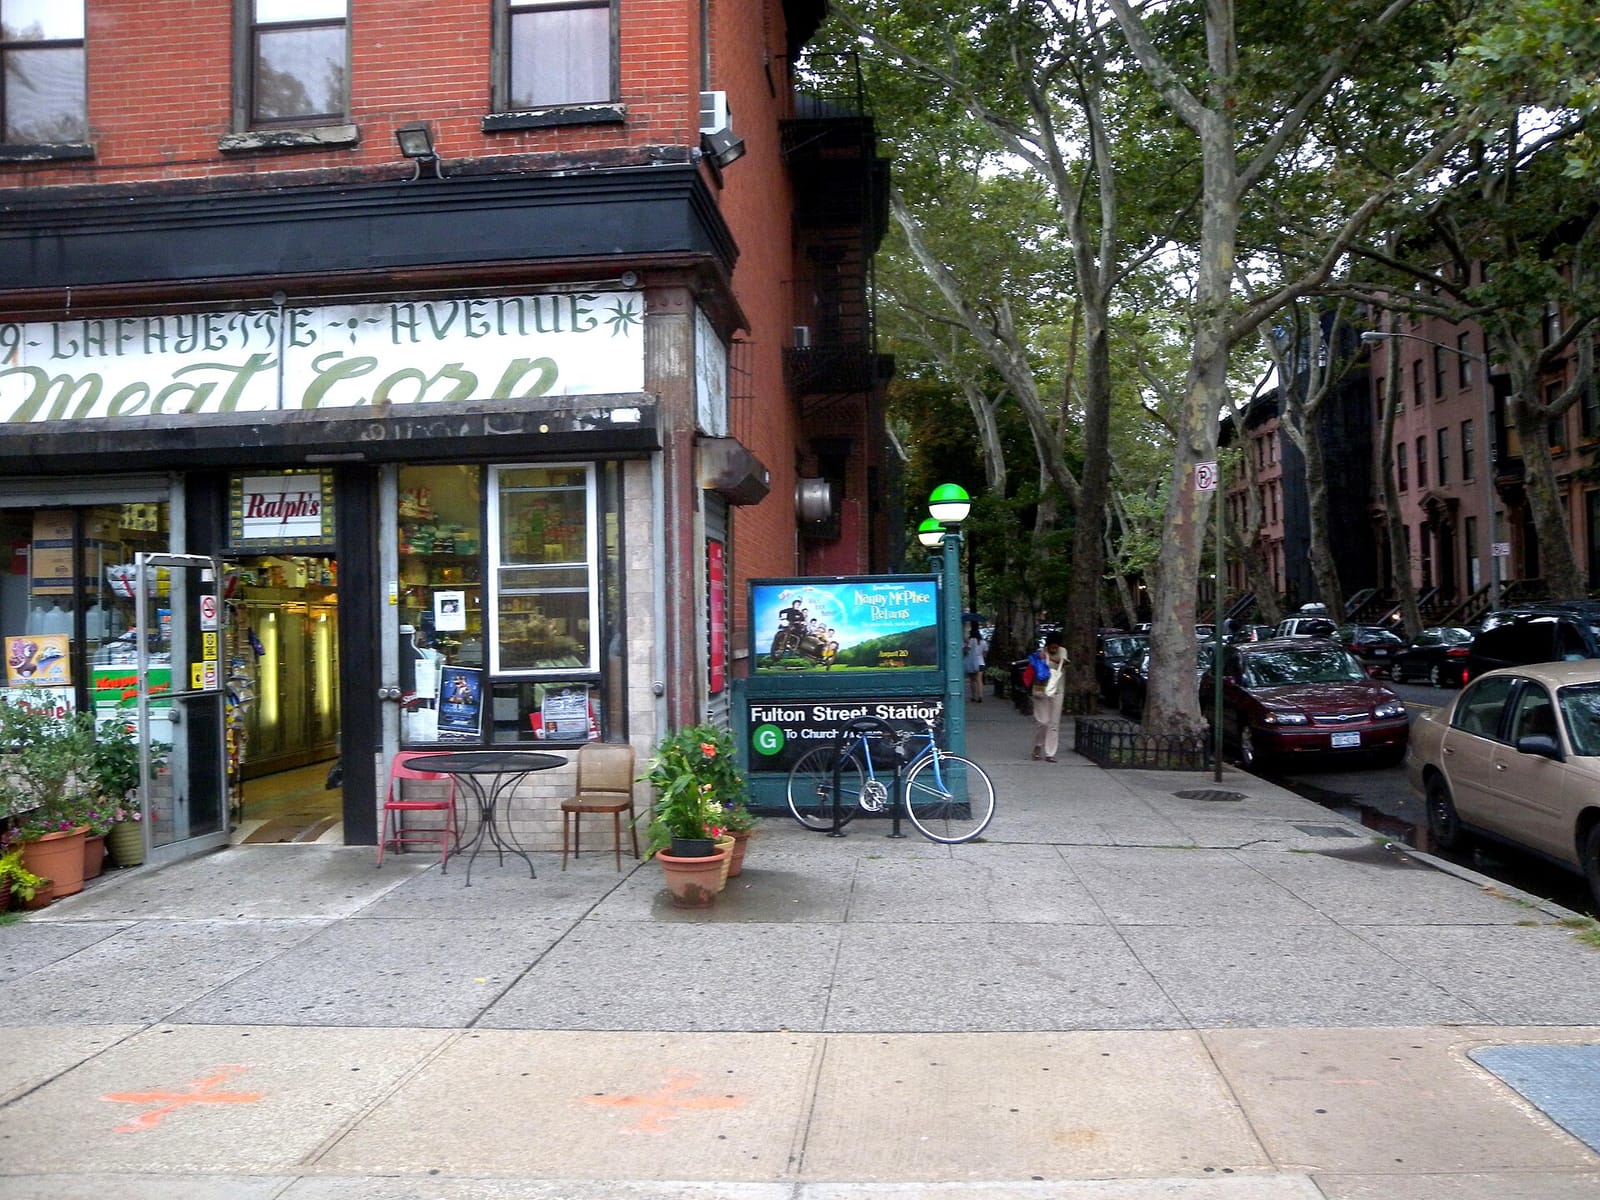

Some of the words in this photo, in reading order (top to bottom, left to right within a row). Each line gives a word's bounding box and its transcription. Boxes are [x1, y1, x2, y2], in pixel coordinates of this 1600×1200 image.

[390, 294, 601, 344] AVENUE
[0, 352, 278, 422] Meat
[245, 491, 320, 525] Ralph's
[854, 589, 888, 608] Nanny
[888, 589, 930, 607] McPhee
[871, 605, 911, 622] Returns
[751, 707, 805, 722] Fulton
[813, 706, 868, 721] Street
[759, 730, 777, 748] G
[784, 729, 798, 738] To
